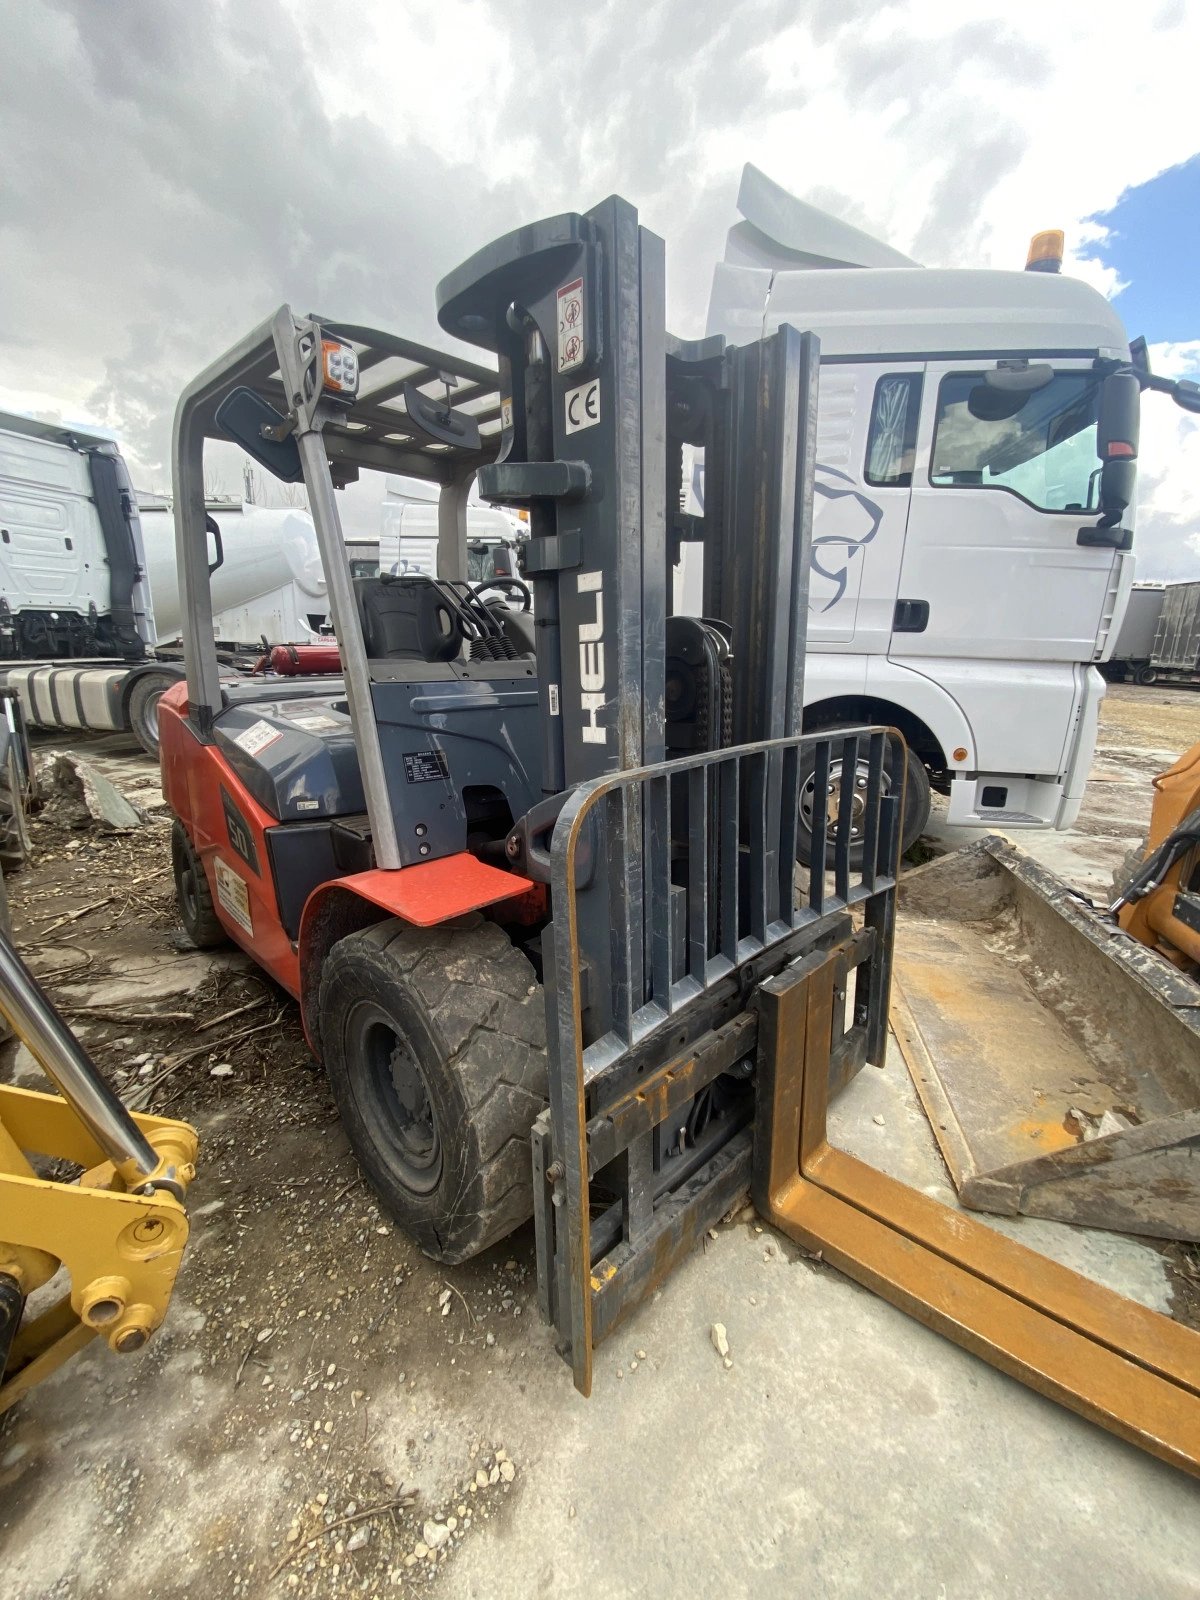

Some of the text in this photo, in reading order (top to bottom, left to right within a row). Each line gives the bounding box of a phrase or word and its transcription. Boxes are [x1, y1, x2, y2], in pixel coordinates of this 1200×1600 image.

[568, 385, 598, 426] CE
[577, 571, 607, 744] HELI
[227, 815, 249, 860] 50
